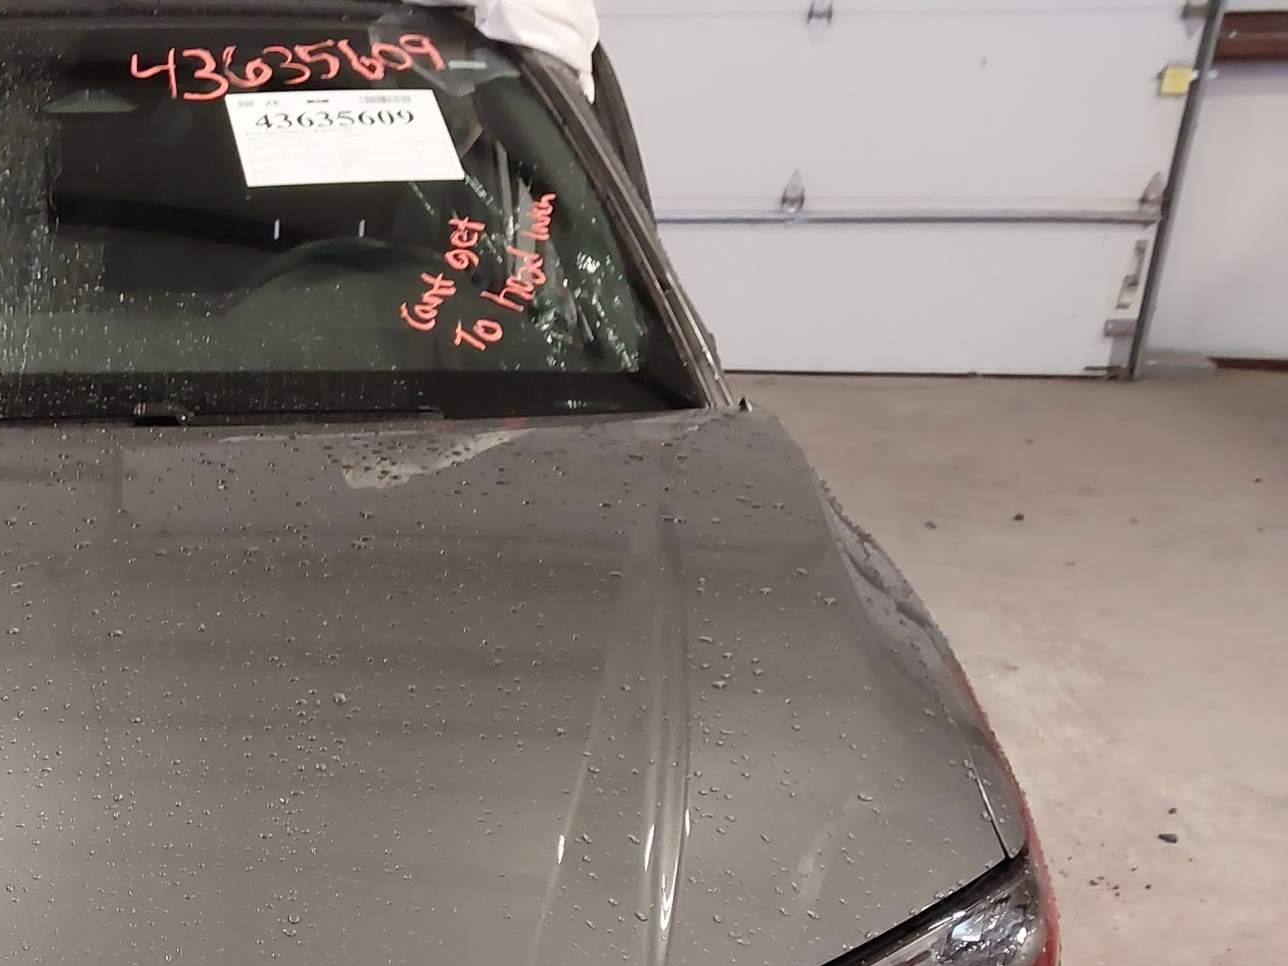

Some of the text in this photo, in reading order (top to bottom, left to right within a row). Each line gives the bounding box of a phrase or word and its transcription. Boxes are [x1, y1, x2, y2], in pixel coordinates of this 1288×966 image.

[130, 33, 447, 100] 43635609
[255, 109, 414, 129] 43635609
[454, 319, 503, 351] To
